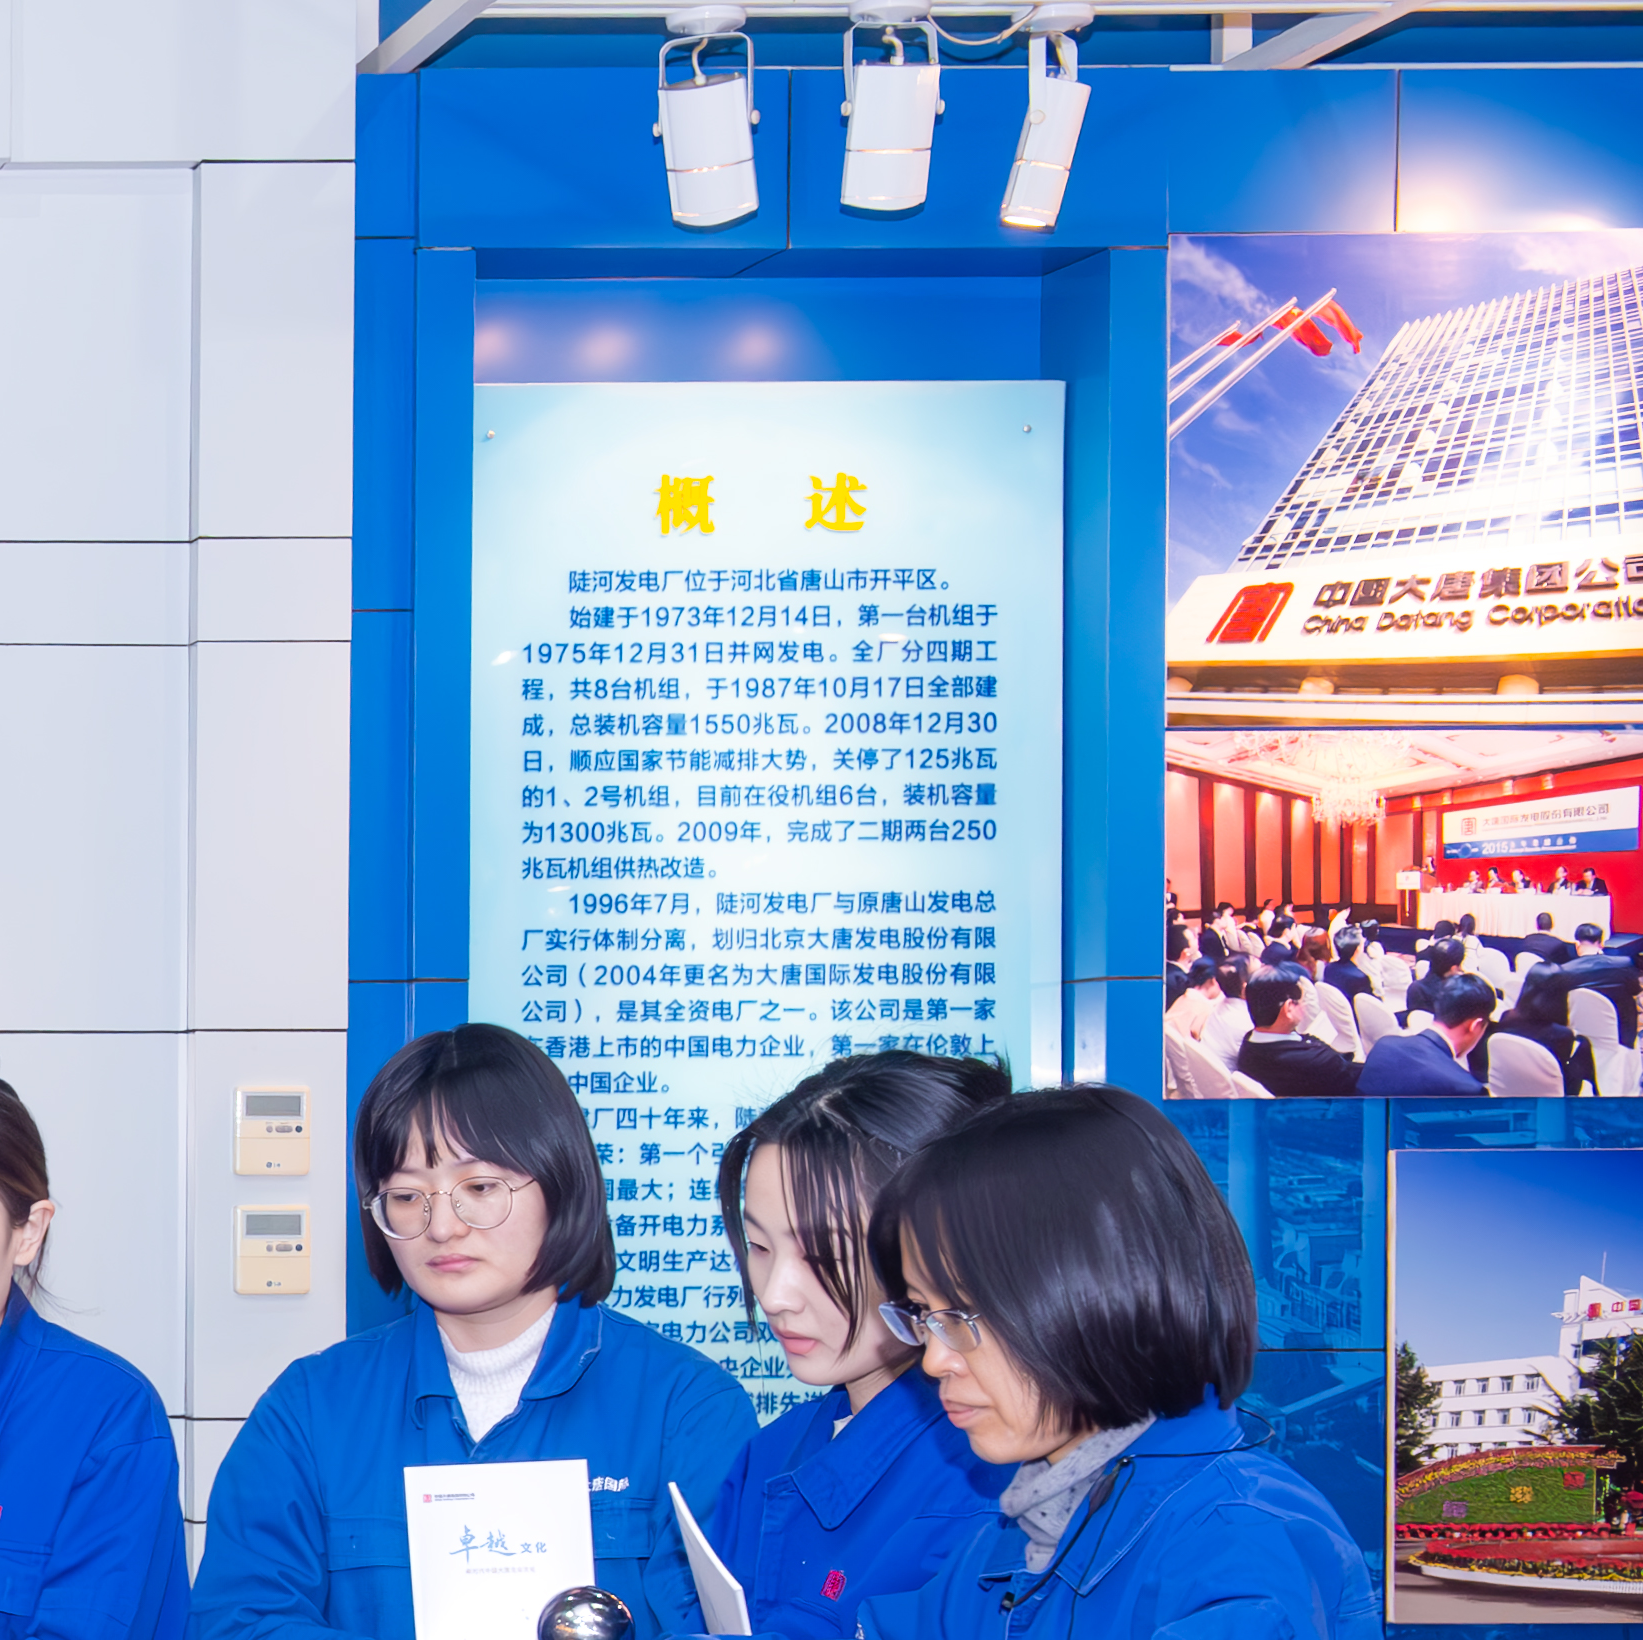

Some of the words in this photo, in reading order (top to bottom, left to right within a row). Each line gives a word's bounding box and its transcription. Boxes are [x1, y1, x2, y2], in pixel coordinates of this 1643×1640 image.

[653, 471, 869, 536] 概述
[568, 568, 948, 593] 陡河发电厂位于河北省唐山市开平区。
[569, 603, 998, 629] 始建于1973年12月14日，第一台机组于
[1302, 613, 1370, 637] China
[1376, 607, 1476, 633] Datang
[522, 639, 997, 664] 1975年12月31日并网发电。全厂分四期工
[521, 674, 997, 701] 程，共8台机组，于1987年10月17日全部建
[521, 711, 997, 737] 成，总装机容量1550兆瓦。2008年12月30
[522, 746, 997, 773] 日，顺应国家节能减排大势，关停了125兆瓦
[521, 782, 997, 809] 的1、2号机组，目前在役机组6台，装机容量
[521, 818, 997, 844] 为1300兆瓦。2009年，完成了二期两台250
[521, 856, 719, 880] 兆瓦机组供热改造。
[569, 889, 996, 915] 1996年7月，陡河发电厂与原唐山发电总
[521, 926, 996, 952] 厂实行体制分离，划归北京大唐发电股份有限
[521, 961, 996, 988] 公司（2004年更名为大唐国际发电股份有限
[521, 997, 996, 1023] 公司），是其全资电厂之一。该公司是第一家
[581, 1106, 769, 1130] 厂四十年来，陡
[448, 1524, 548, 1564] 卓越文化
